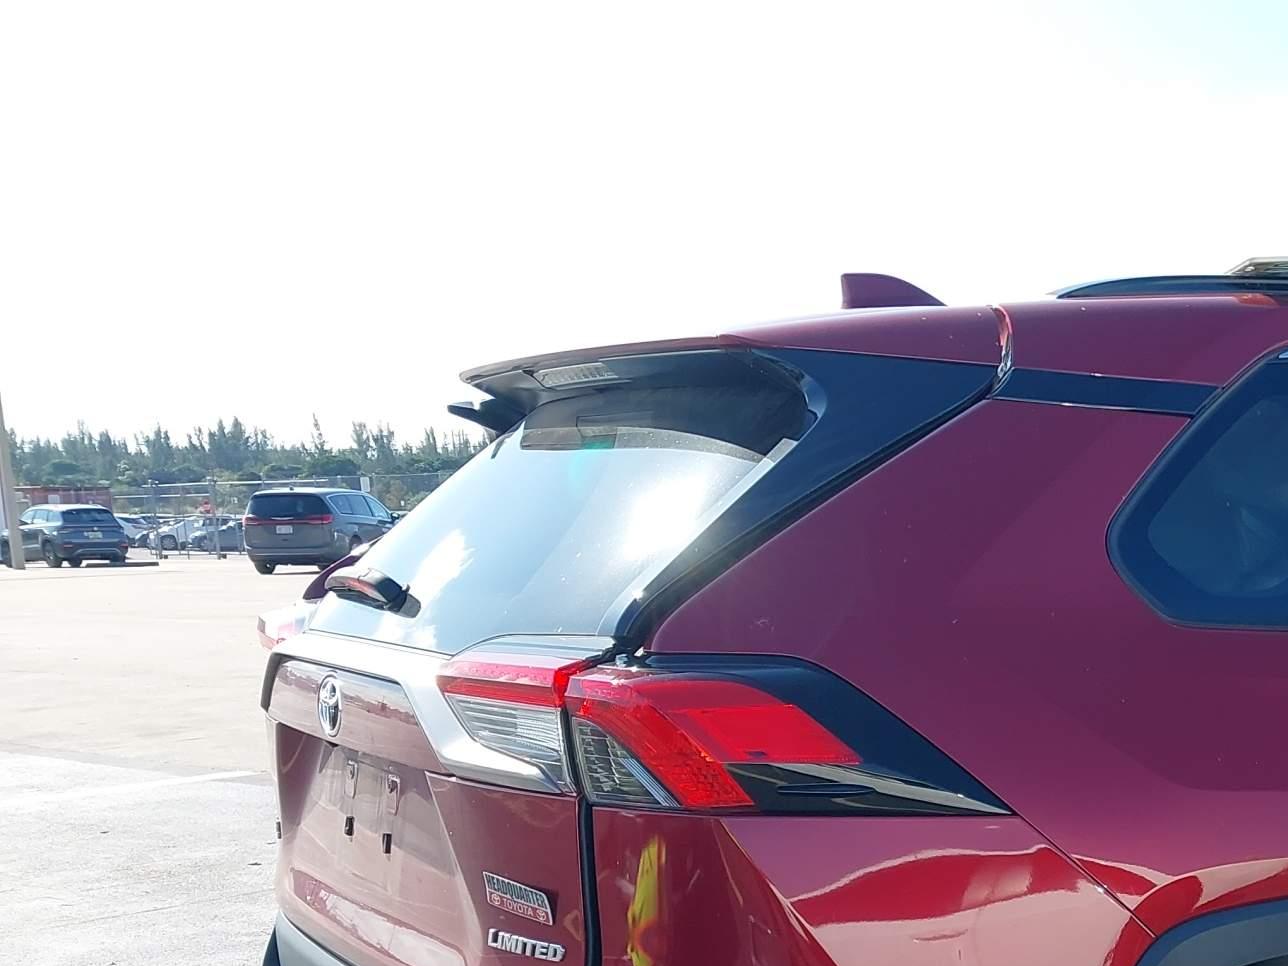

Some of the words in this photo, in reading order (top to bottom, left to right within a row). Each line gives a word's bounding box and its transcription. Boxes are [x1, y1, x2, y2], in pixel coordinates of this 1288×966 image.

[485, 873, 548, 910] HEADQUARTER
[502, 898, 534, 917] TOYOTA
[487, 928, 566, 962] LIMITED
